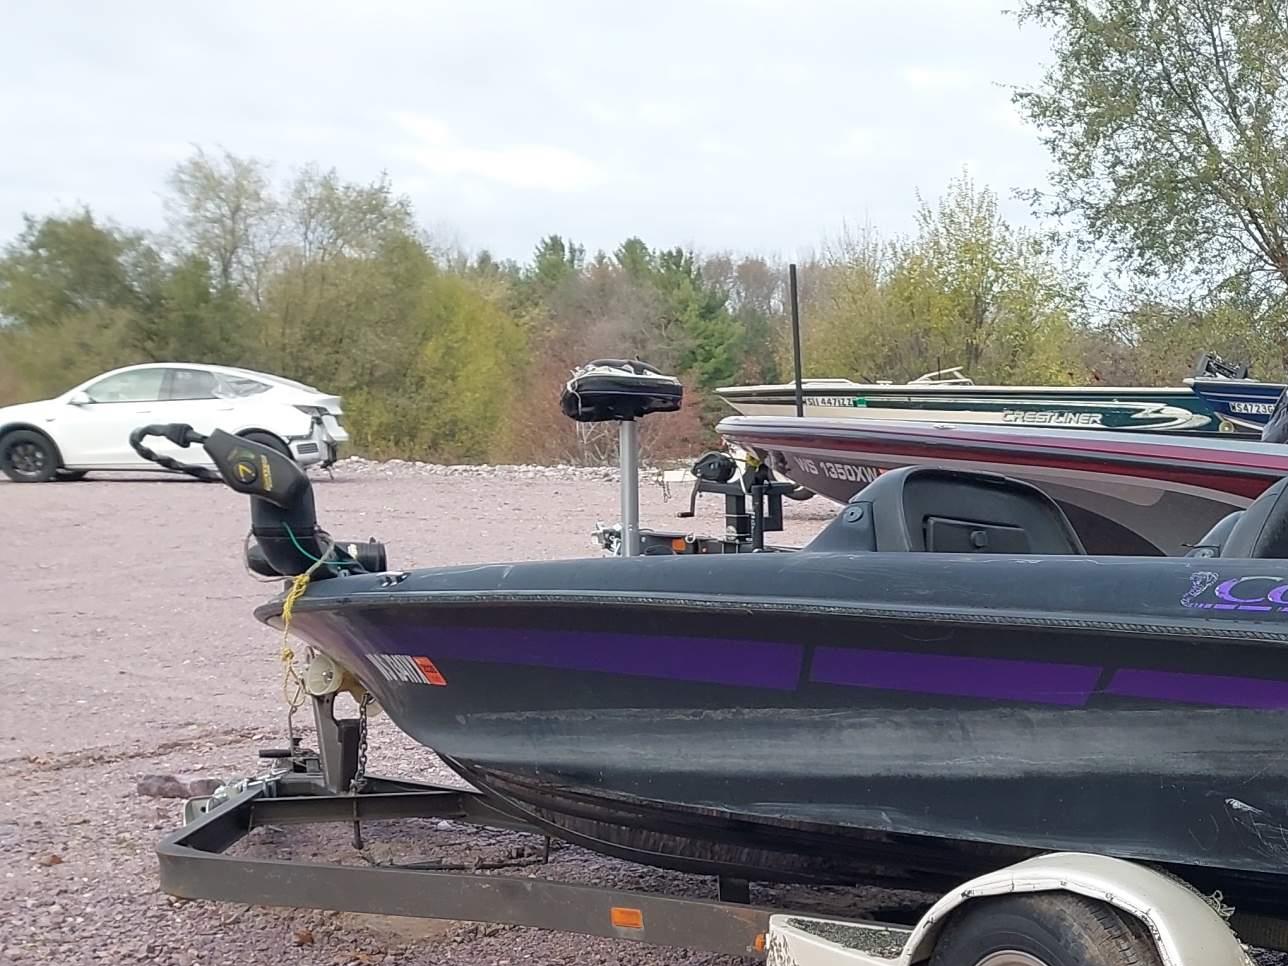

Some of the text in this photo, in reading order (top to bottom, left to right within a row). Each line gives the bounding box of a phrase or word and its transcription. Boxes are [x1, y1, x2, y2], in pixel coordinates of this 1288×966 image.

[1002, 408, 1102, 425] CRESTLINER
[1229, 402, 1276, 414] WS4723G
[794, 456, 877, 483] WS 1350XW
